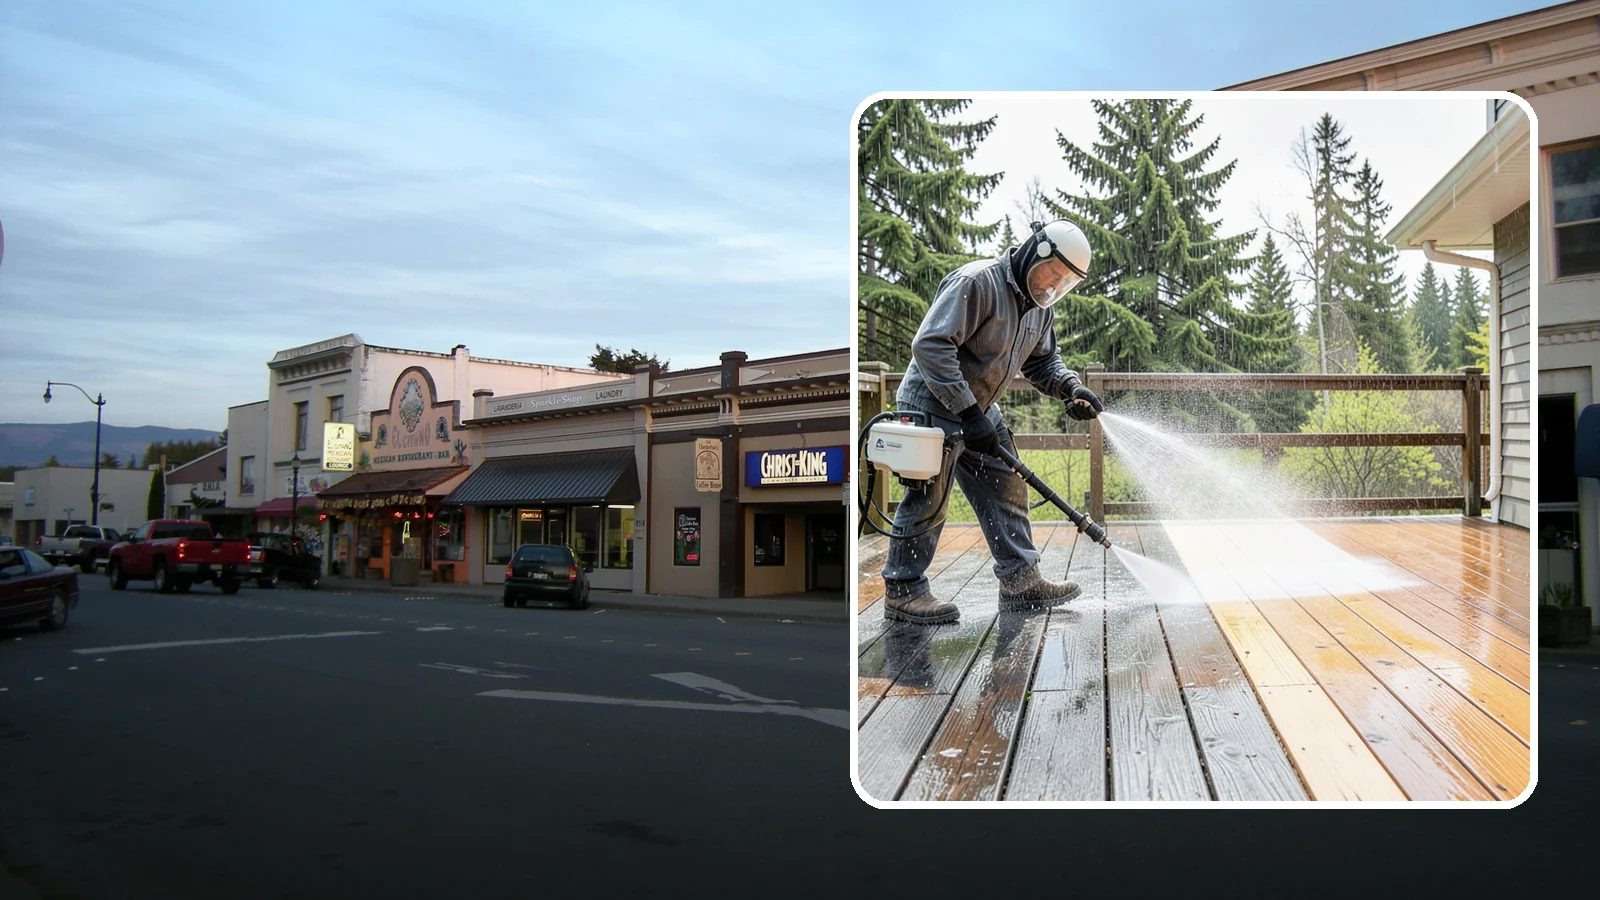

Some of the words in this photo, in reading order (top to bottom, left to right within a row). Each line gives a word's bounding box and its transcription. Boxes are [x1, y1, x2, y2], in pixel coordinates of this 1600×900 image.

[562, 394, 582, 405] Shop
[595, 389, 624, 400] LAUNDRY
[493, 402, 522, 412] LAVANDERIA
[373, 454, 395, 463] MEXICAN
[397, 452, 433, 462] RESTAURANT
[438, 450, 450, 459] BAR
[761, 452, 797, 478] CHRIST
[799, 450, 827, 476] KING
